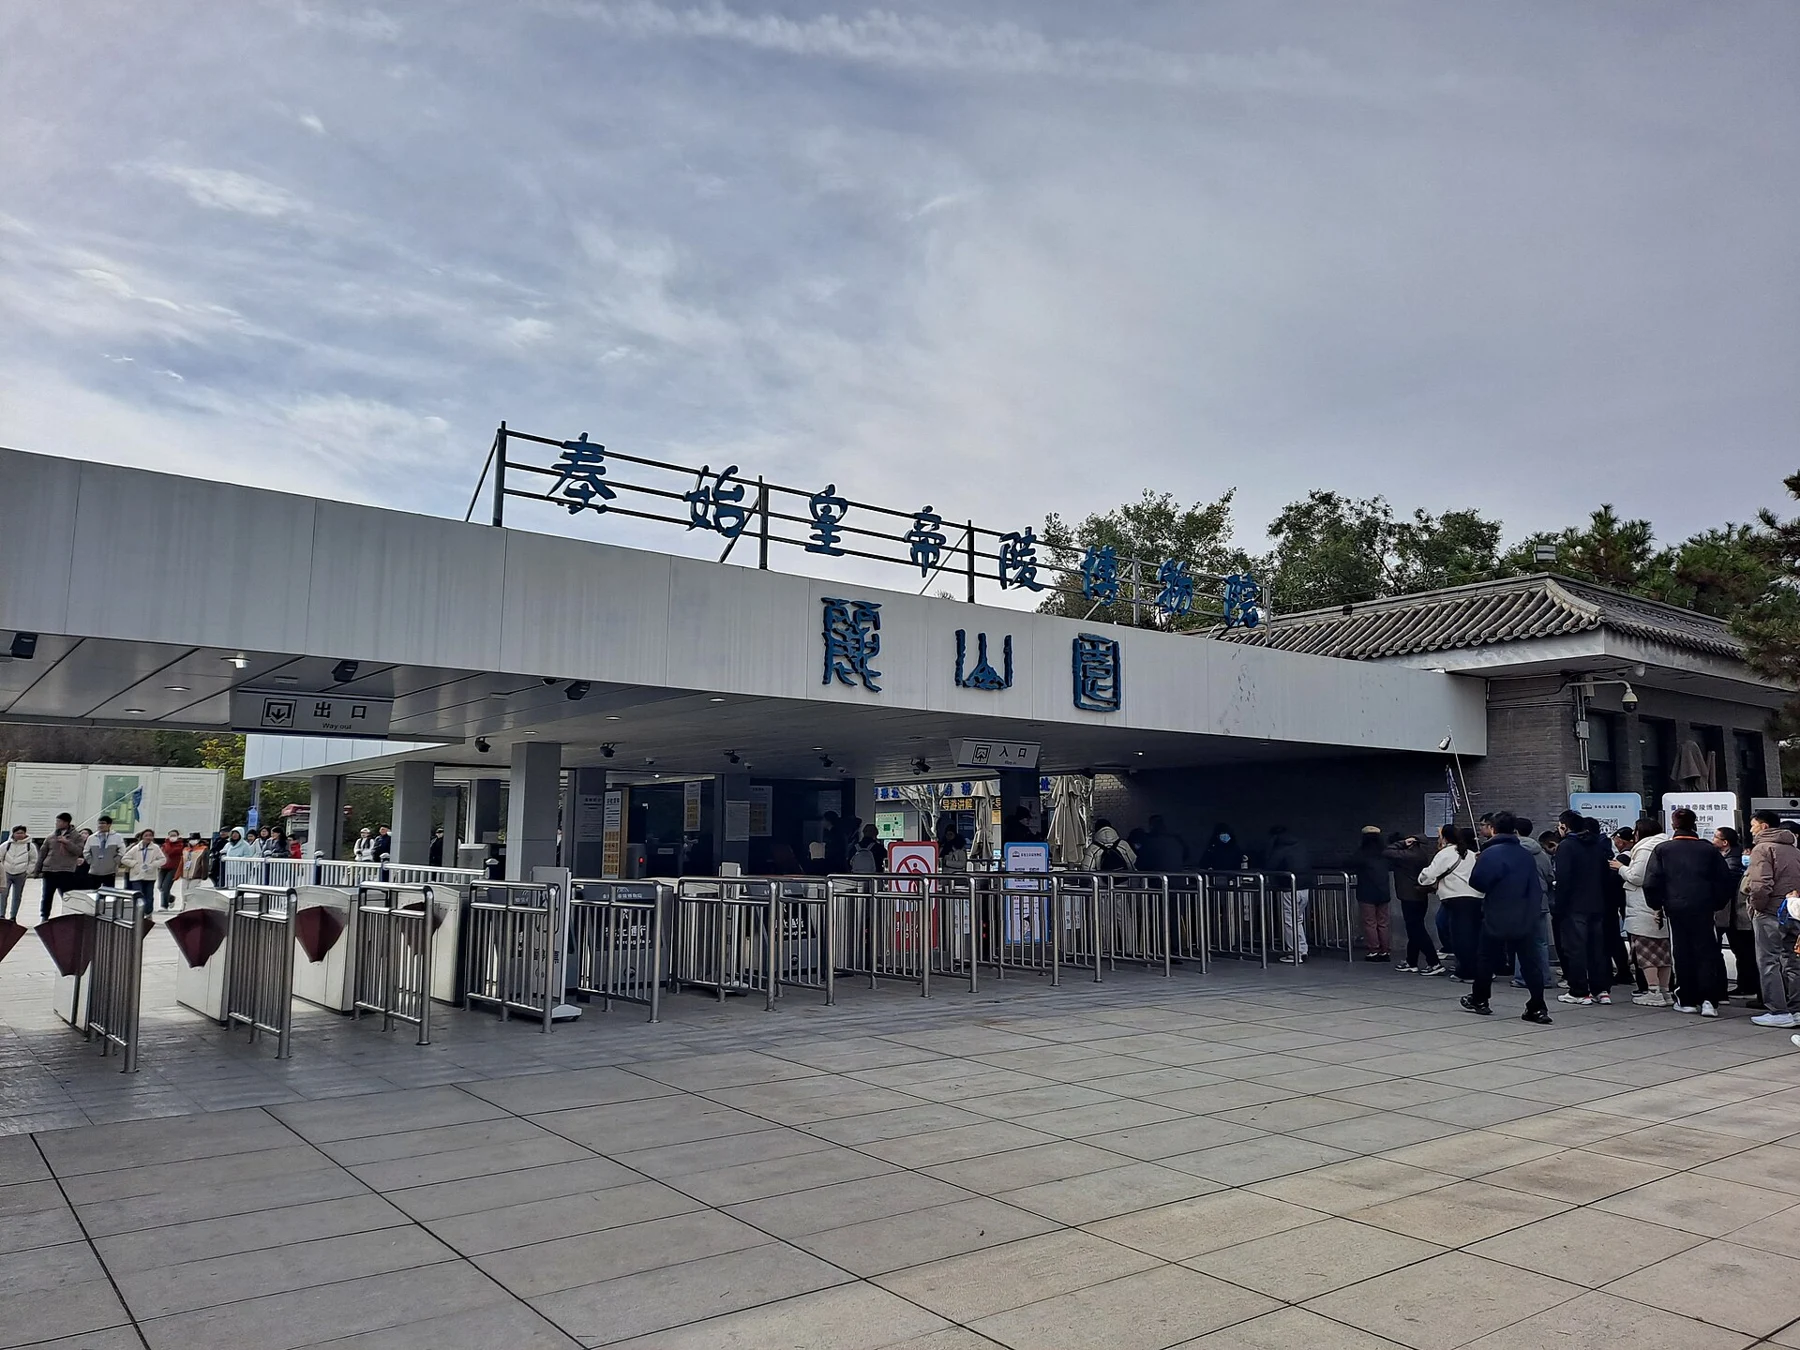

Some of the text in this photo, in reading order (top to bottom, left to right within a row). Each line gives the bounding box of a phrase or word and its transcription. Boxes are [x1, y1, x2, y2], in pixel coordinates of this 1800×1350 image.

[546, 432, 1259, 628] 秦始皇帝陵博物院
[313, 701, 367, 719] 出口
[322, 722, 338, 730] Way
[999, 745, 1027, 758] 入口
